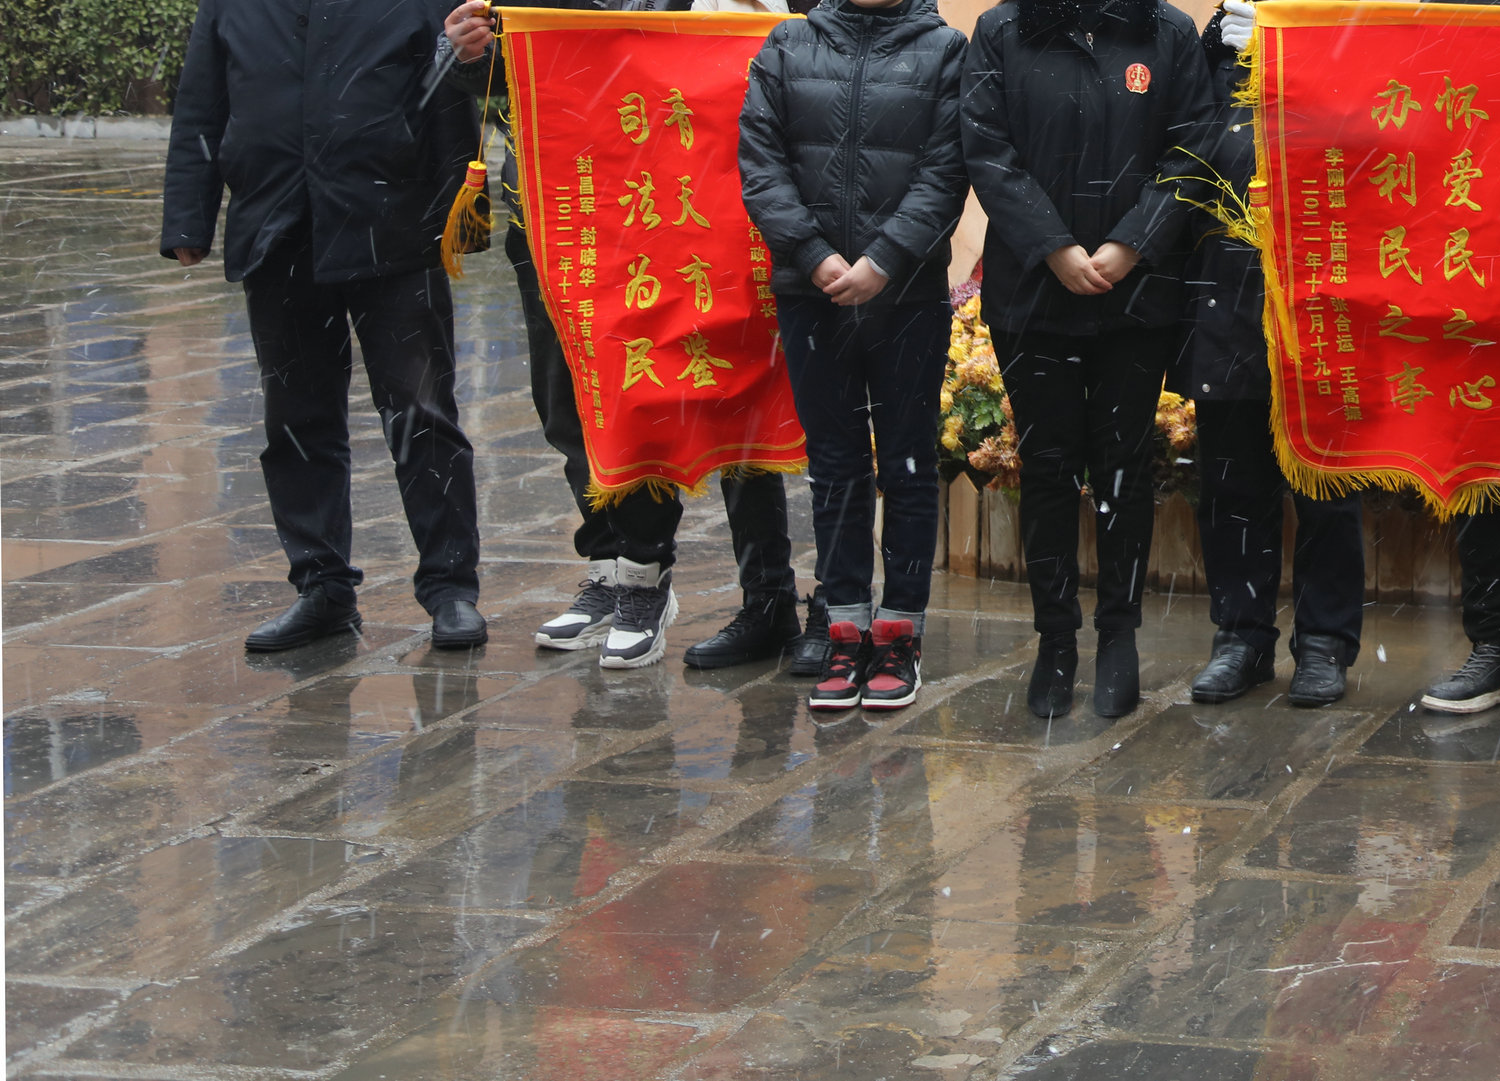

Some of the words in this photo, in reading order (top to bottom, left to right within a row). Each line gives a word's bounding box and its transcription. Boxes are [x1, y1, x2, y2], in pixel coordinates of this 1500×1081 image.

[576, 155, 597, 216] 封昌军
[1325, 147, 1347, 209] 李刚强
[579, 226, 598, 288] 封晓华
[617, 92, 666, 392] 司法为民
[1329, 220, 1348, 285] 任国忠
[1370, 79, 1433, 414] 办利民之事
[1434, 76, 1497, 410] 怀爱民之心
[1330, 297, 1355, 353] 张合运
